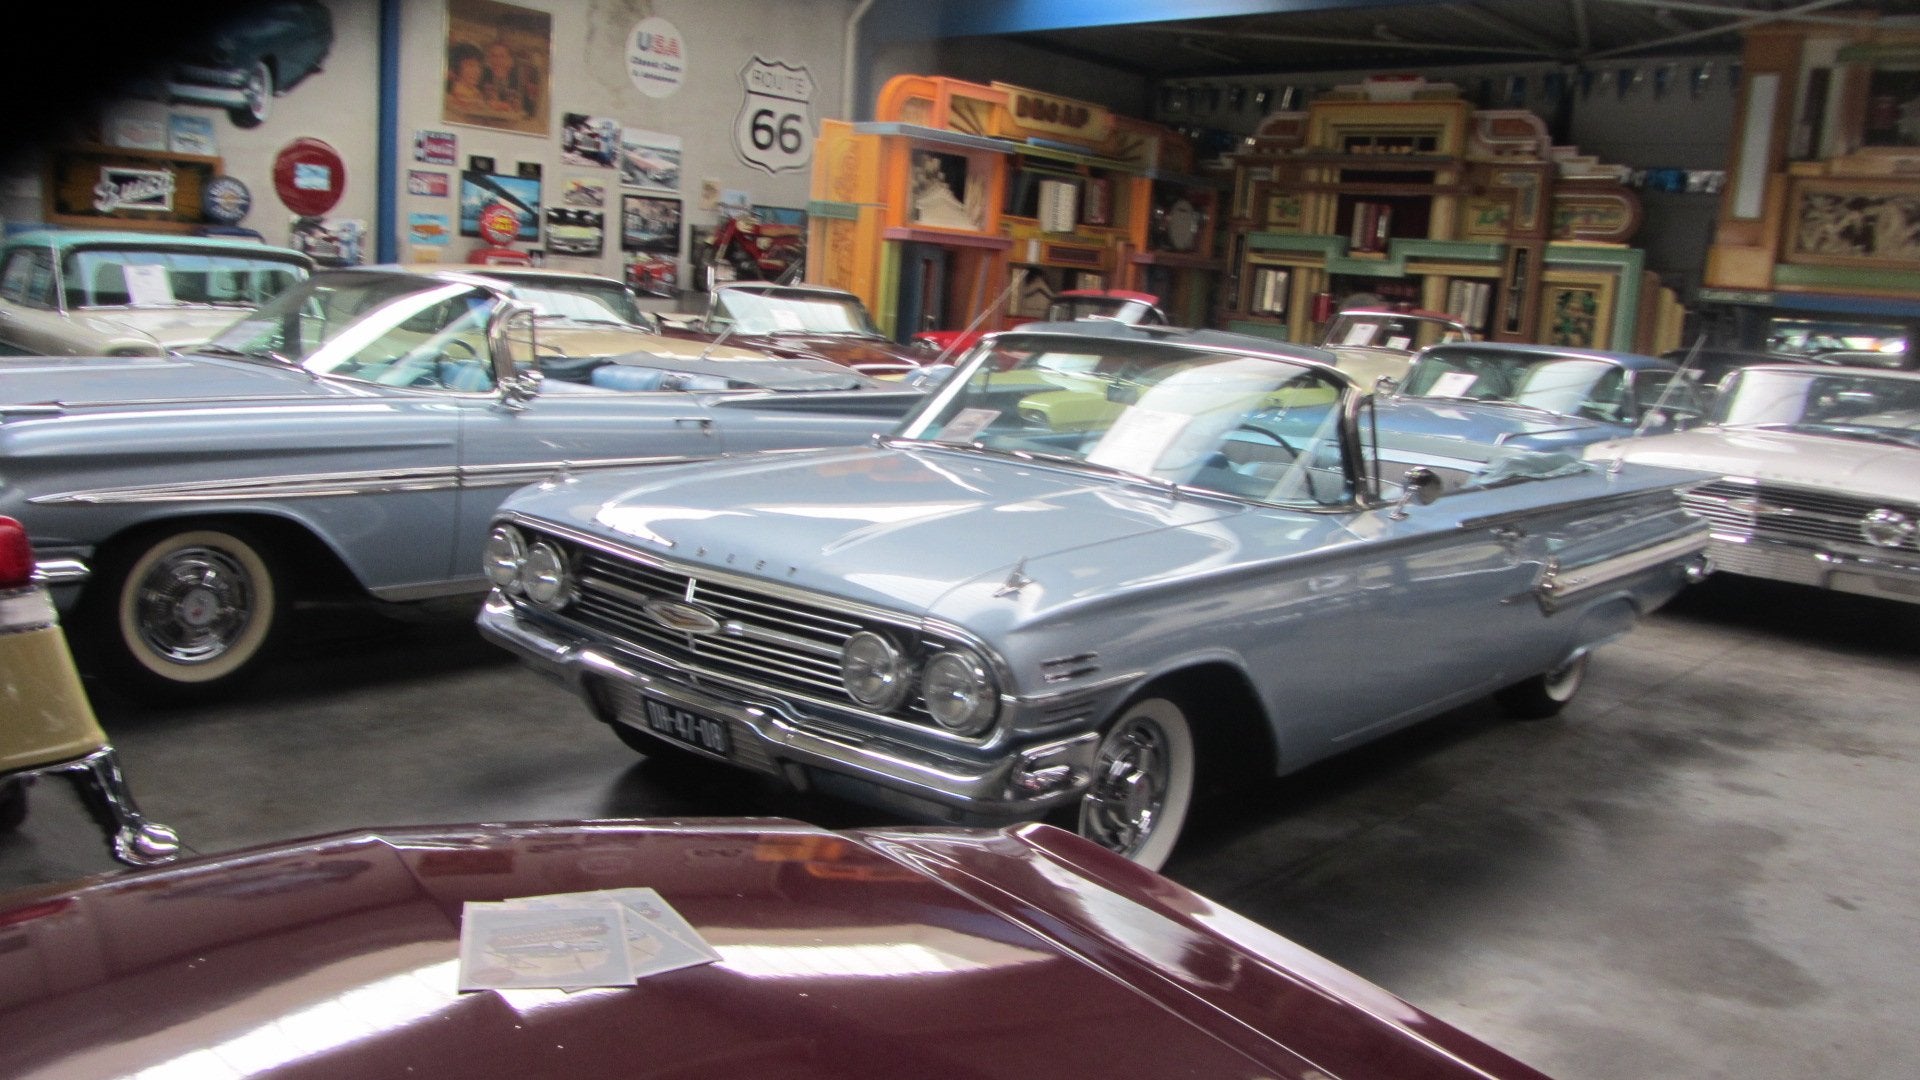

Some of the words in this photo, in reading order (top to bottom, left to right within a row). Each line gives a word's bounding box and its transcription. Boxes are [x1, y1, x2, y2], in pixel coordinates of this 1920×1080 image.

[635, 31, 681, 58] USA
[753, 69, 806, 95] ROUTE
[751, 108, 802, 154] 66
